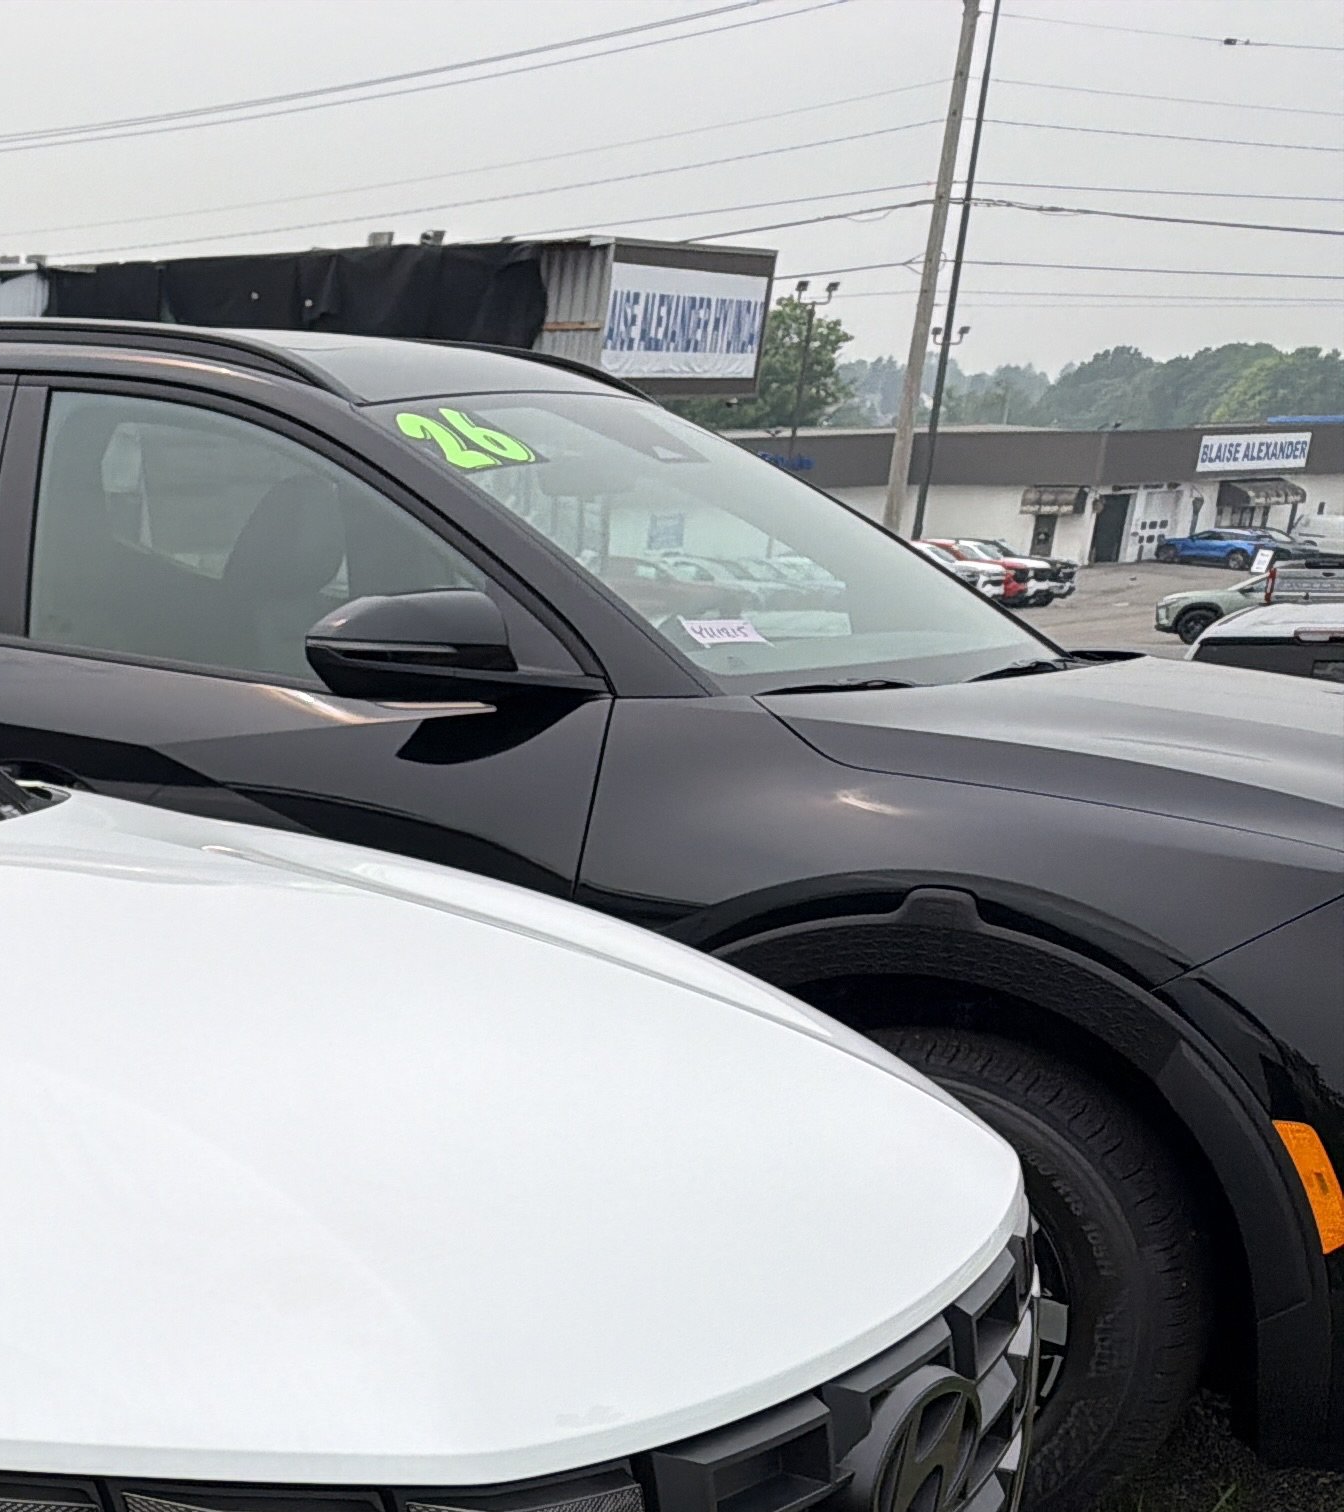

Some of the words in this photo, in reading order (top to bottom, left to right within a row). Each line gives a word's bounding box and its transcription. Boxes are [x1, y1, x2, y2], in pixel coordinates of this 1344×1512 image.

[640, 292, 713, 352] ALEXANDER
[395, 407, 536, 470] 26
[1200, 442, 1241, 464] BLAISE
[1241, 440, 1308, 462] ALEXANDER
